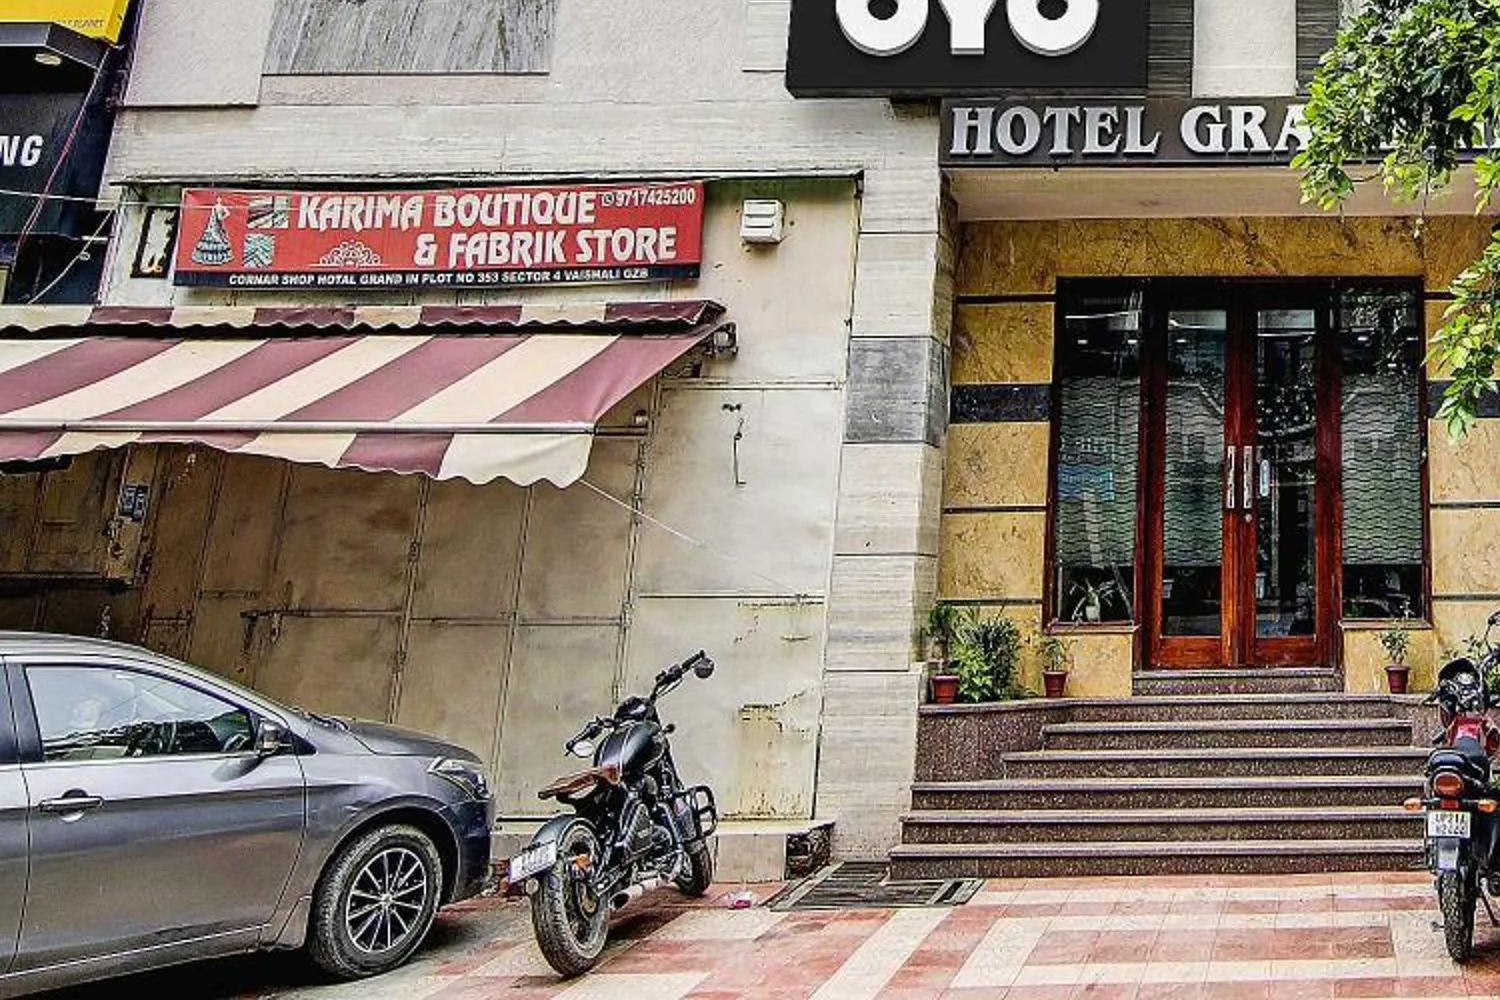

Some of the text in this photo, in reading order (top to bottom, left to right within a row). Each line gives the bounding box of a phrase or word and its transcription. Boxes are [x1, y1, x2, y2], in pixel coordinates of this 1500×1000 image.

[949, 105, 1313, 155] HOTEL GRA
[298, 191, 597, 232] KARIMA BOUTIQUE
[615, 187, 696, 207] 9717425200
[413, 227, 678, 269] & FABRIK STORE
[229, 273, 279, 285] CORNAR
[281, 273, 315, 286] SHOP
[359, 274, 403, 285] GRAND
[405, 274, 419, 284] IN
[421, 273, 453, 284] PLOT
[501, 271, 551, 283] SECTOR
